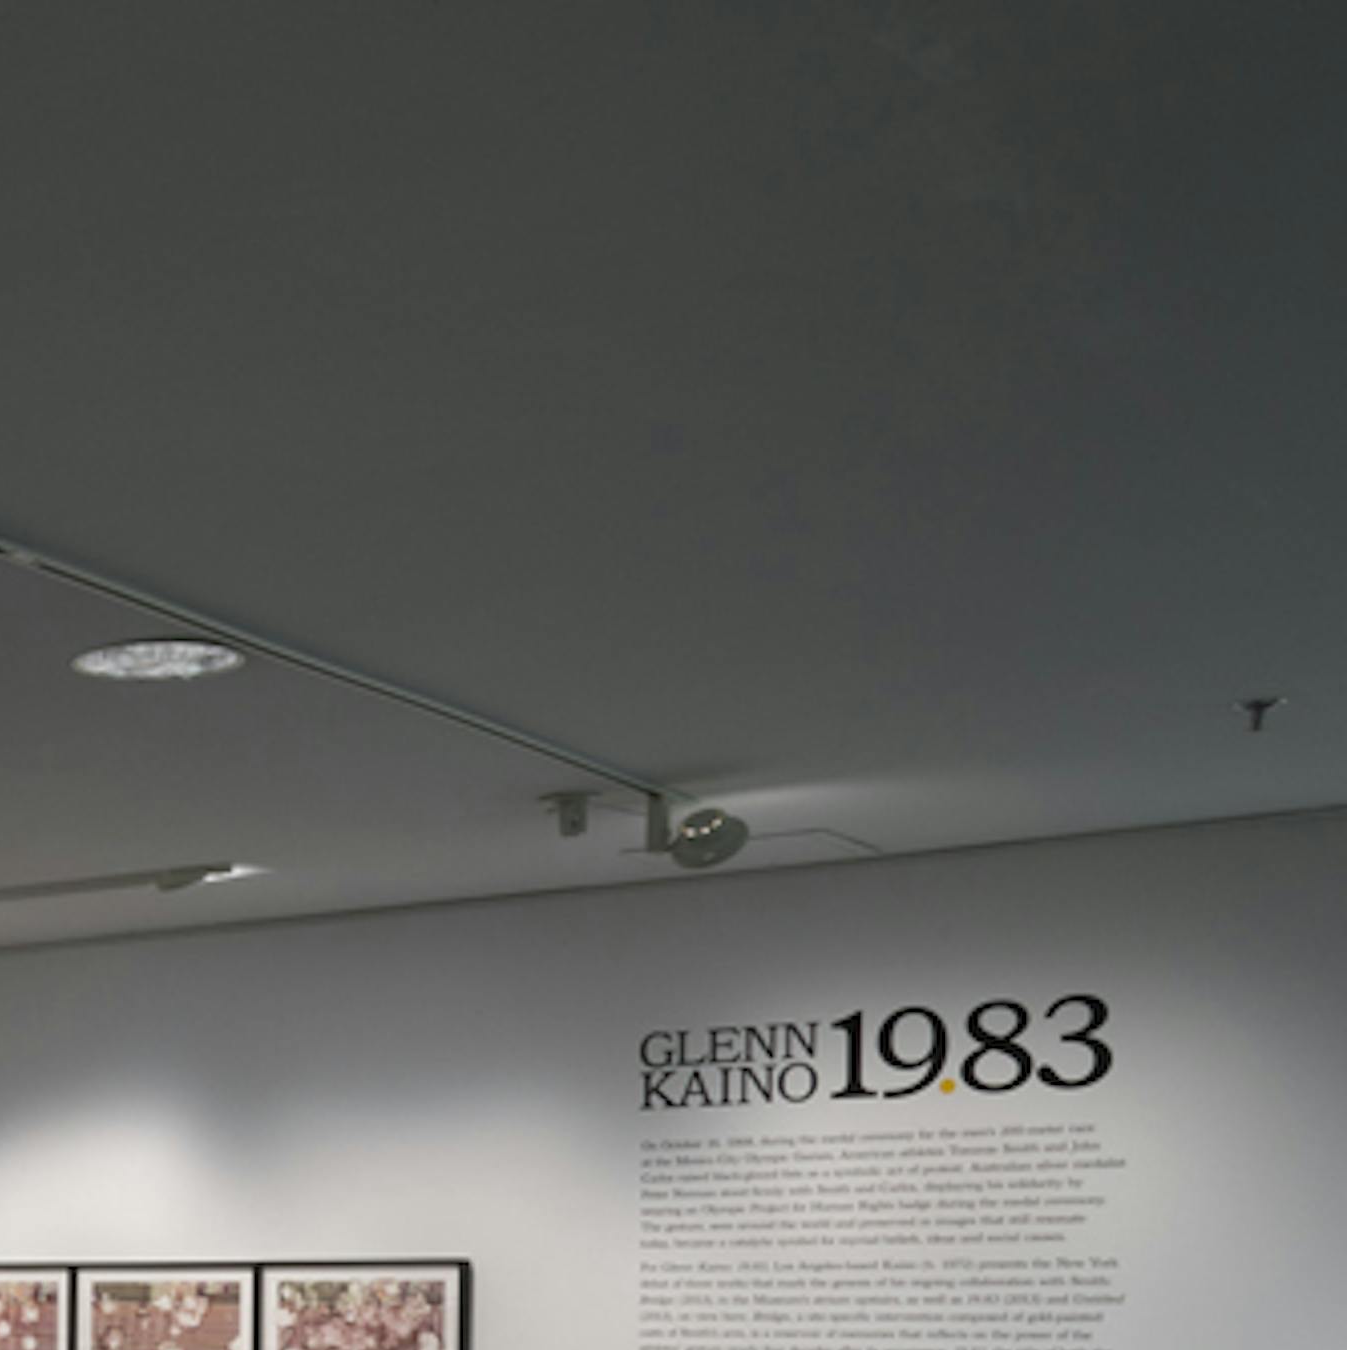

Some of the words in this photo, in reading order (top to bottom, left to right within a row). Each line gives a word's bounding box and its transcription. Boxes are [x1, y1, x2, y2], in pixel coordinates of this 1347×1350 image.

[639, 1021, 820, 1069] GLENN
[829, 993, 1114, 1101] 19.83
[639, 1062, 819, 1111] KAINO
